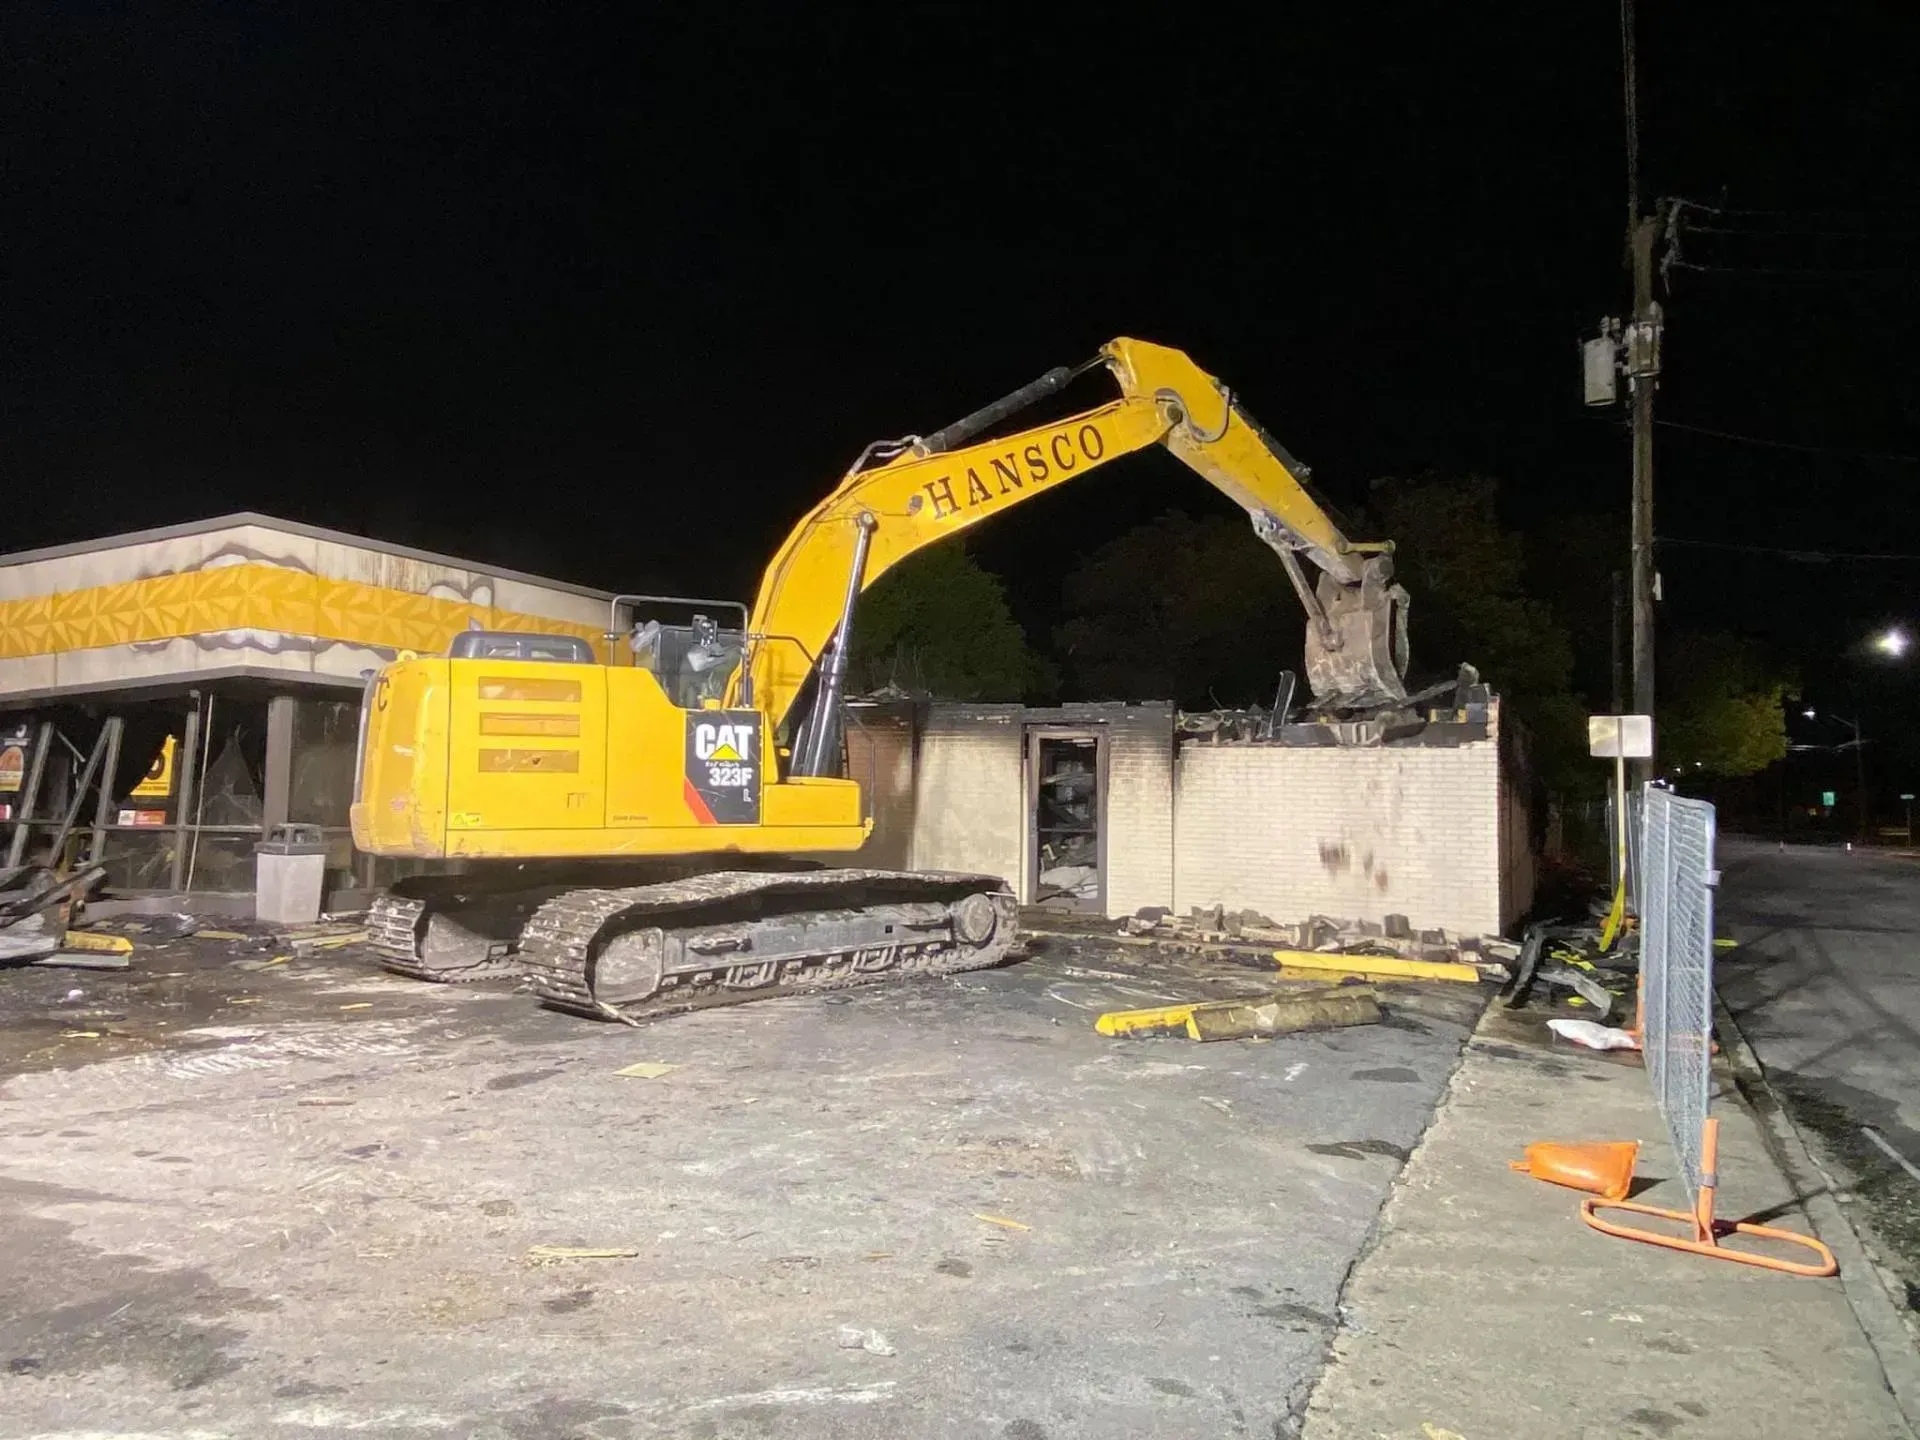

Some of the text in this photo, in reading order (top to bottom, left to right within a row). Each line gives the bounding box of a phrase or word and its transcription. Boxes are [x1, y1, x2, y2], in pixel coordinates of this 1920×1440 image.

[923, 424, 1104, 520] HANSCO
[695, 724, 753, 760] CAT
[709, 767, 753, 786] 323F
